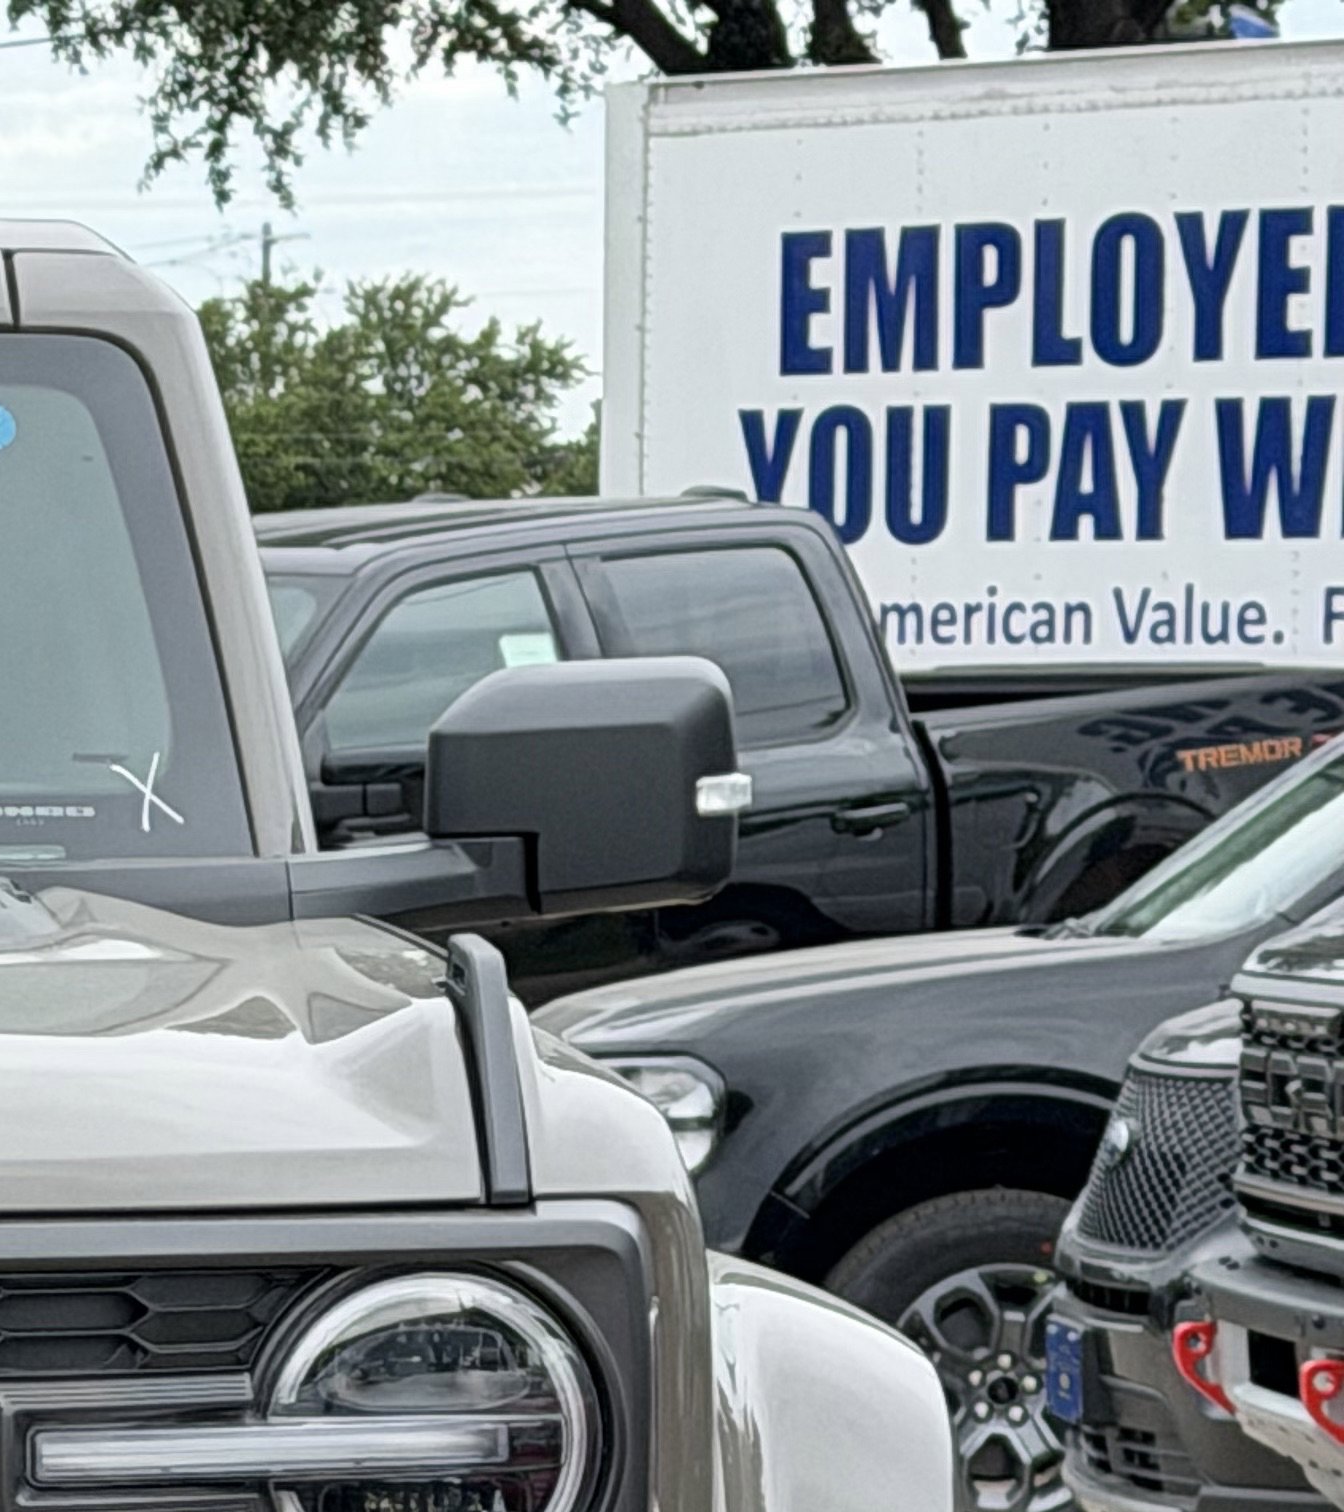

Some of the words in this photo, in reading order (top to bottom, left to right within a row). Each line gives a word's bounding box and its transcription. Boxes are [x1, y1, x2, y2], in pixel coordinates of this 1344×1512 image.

[738, 402, 952, 546] YOU
[986, 397, 1189, 543] PAY
[1214, 393, 1344, 540] W
[879, 585, 1092, 647] merican
[1112, 582, 1285, 647] Value.
[1176, 736, 1303, 773] TREMOR
